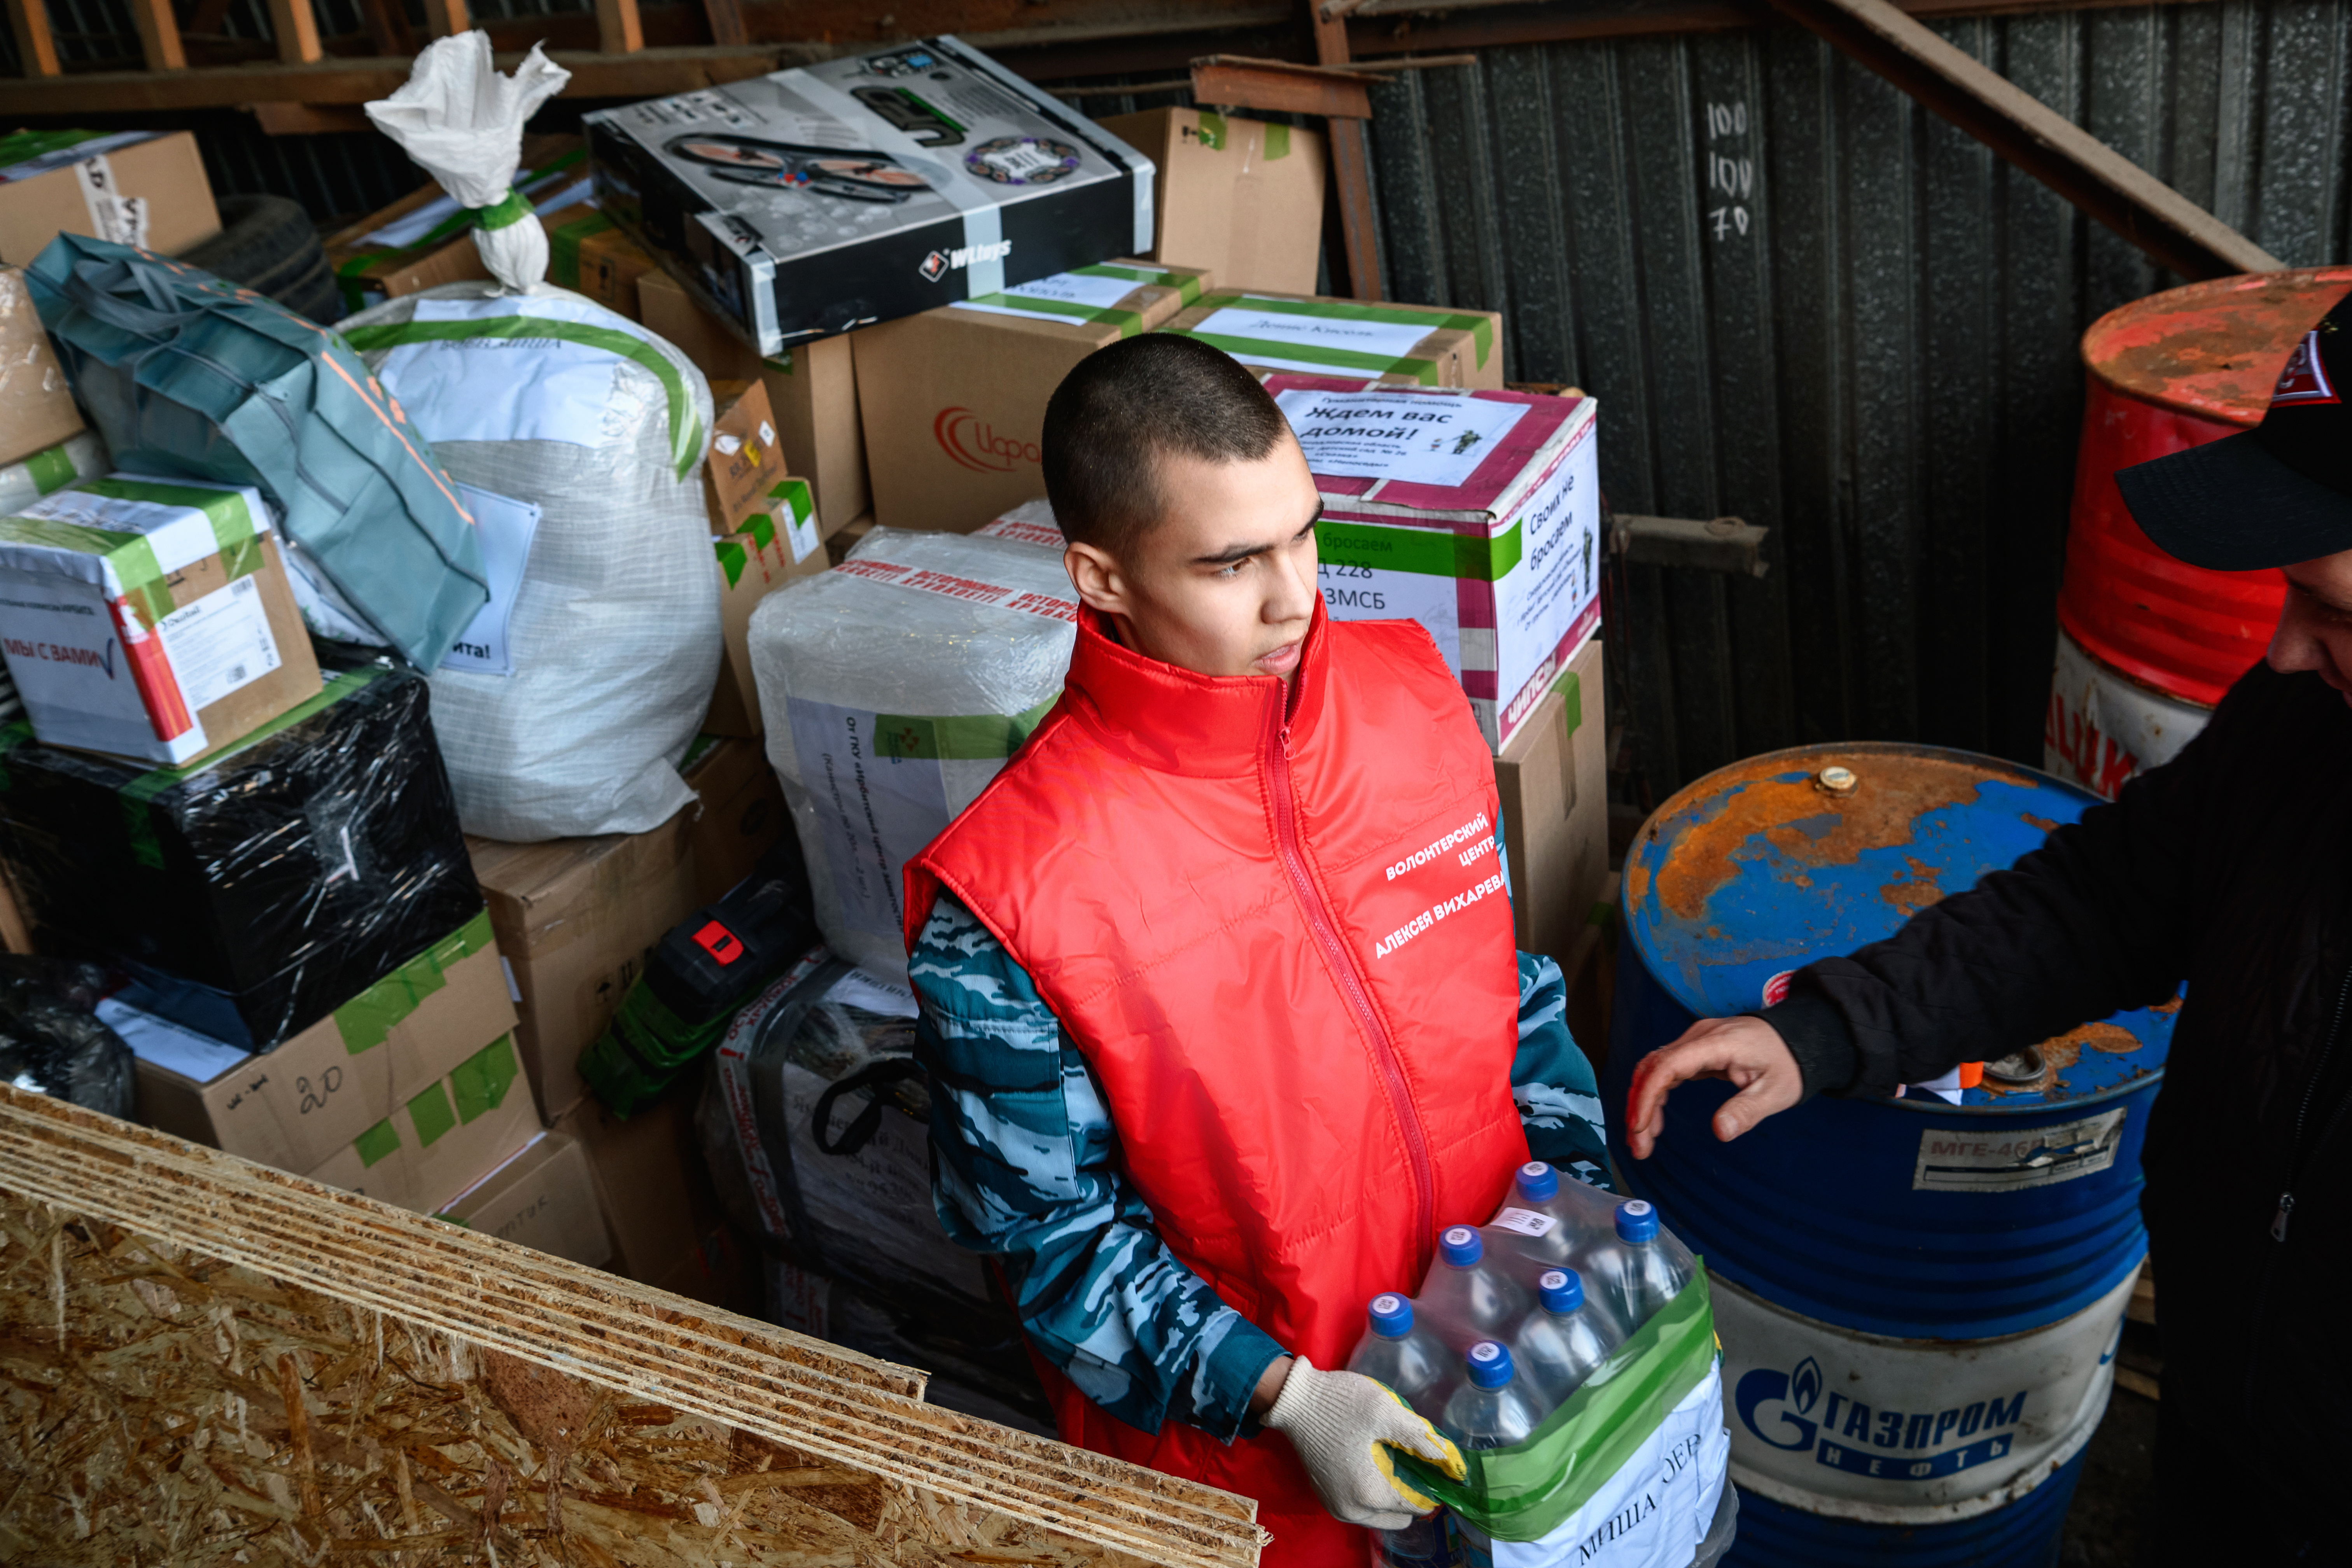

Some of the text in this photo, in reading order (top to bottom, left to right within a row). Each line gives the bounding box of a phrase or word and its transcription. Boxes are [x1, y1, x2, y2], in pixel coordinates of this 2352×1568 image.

[1708, 102, 1747, 140] 100
[1709, 206, 1749, 242] 70
[1299, 427, 1419, 440] домой!
[1304, 407, 1453, 424] Ждем вас
[1530, 490, 1560, 535] Своих
[1562, 475, 1574, 500] не
[1323, 532, 1393, 553] бросаем
[1531, 511, 1572, 571] бросаем
[1335, 559, 1372, 579] 228
[4, 638, 101, 668] МЫ С ВАМИ
[1508, 649, 1556, 724] ЧИПСЫ
[1385, 812, 1489, 881] ВОЛОНТЕРСКИЙ
[1458, 835, 1495, 867] ЦЕНТР
[1376, 910, 1433, 959] АЛЕКСЕЯ
[296, 1066, 343, 1115] 20
[1824, 1391, 2027, 1450] ГАЗПРОМ
[1825, 1440, 2004, 1477] НЕФТЬ
[1579, 1493, 1656, 1567] МИША
